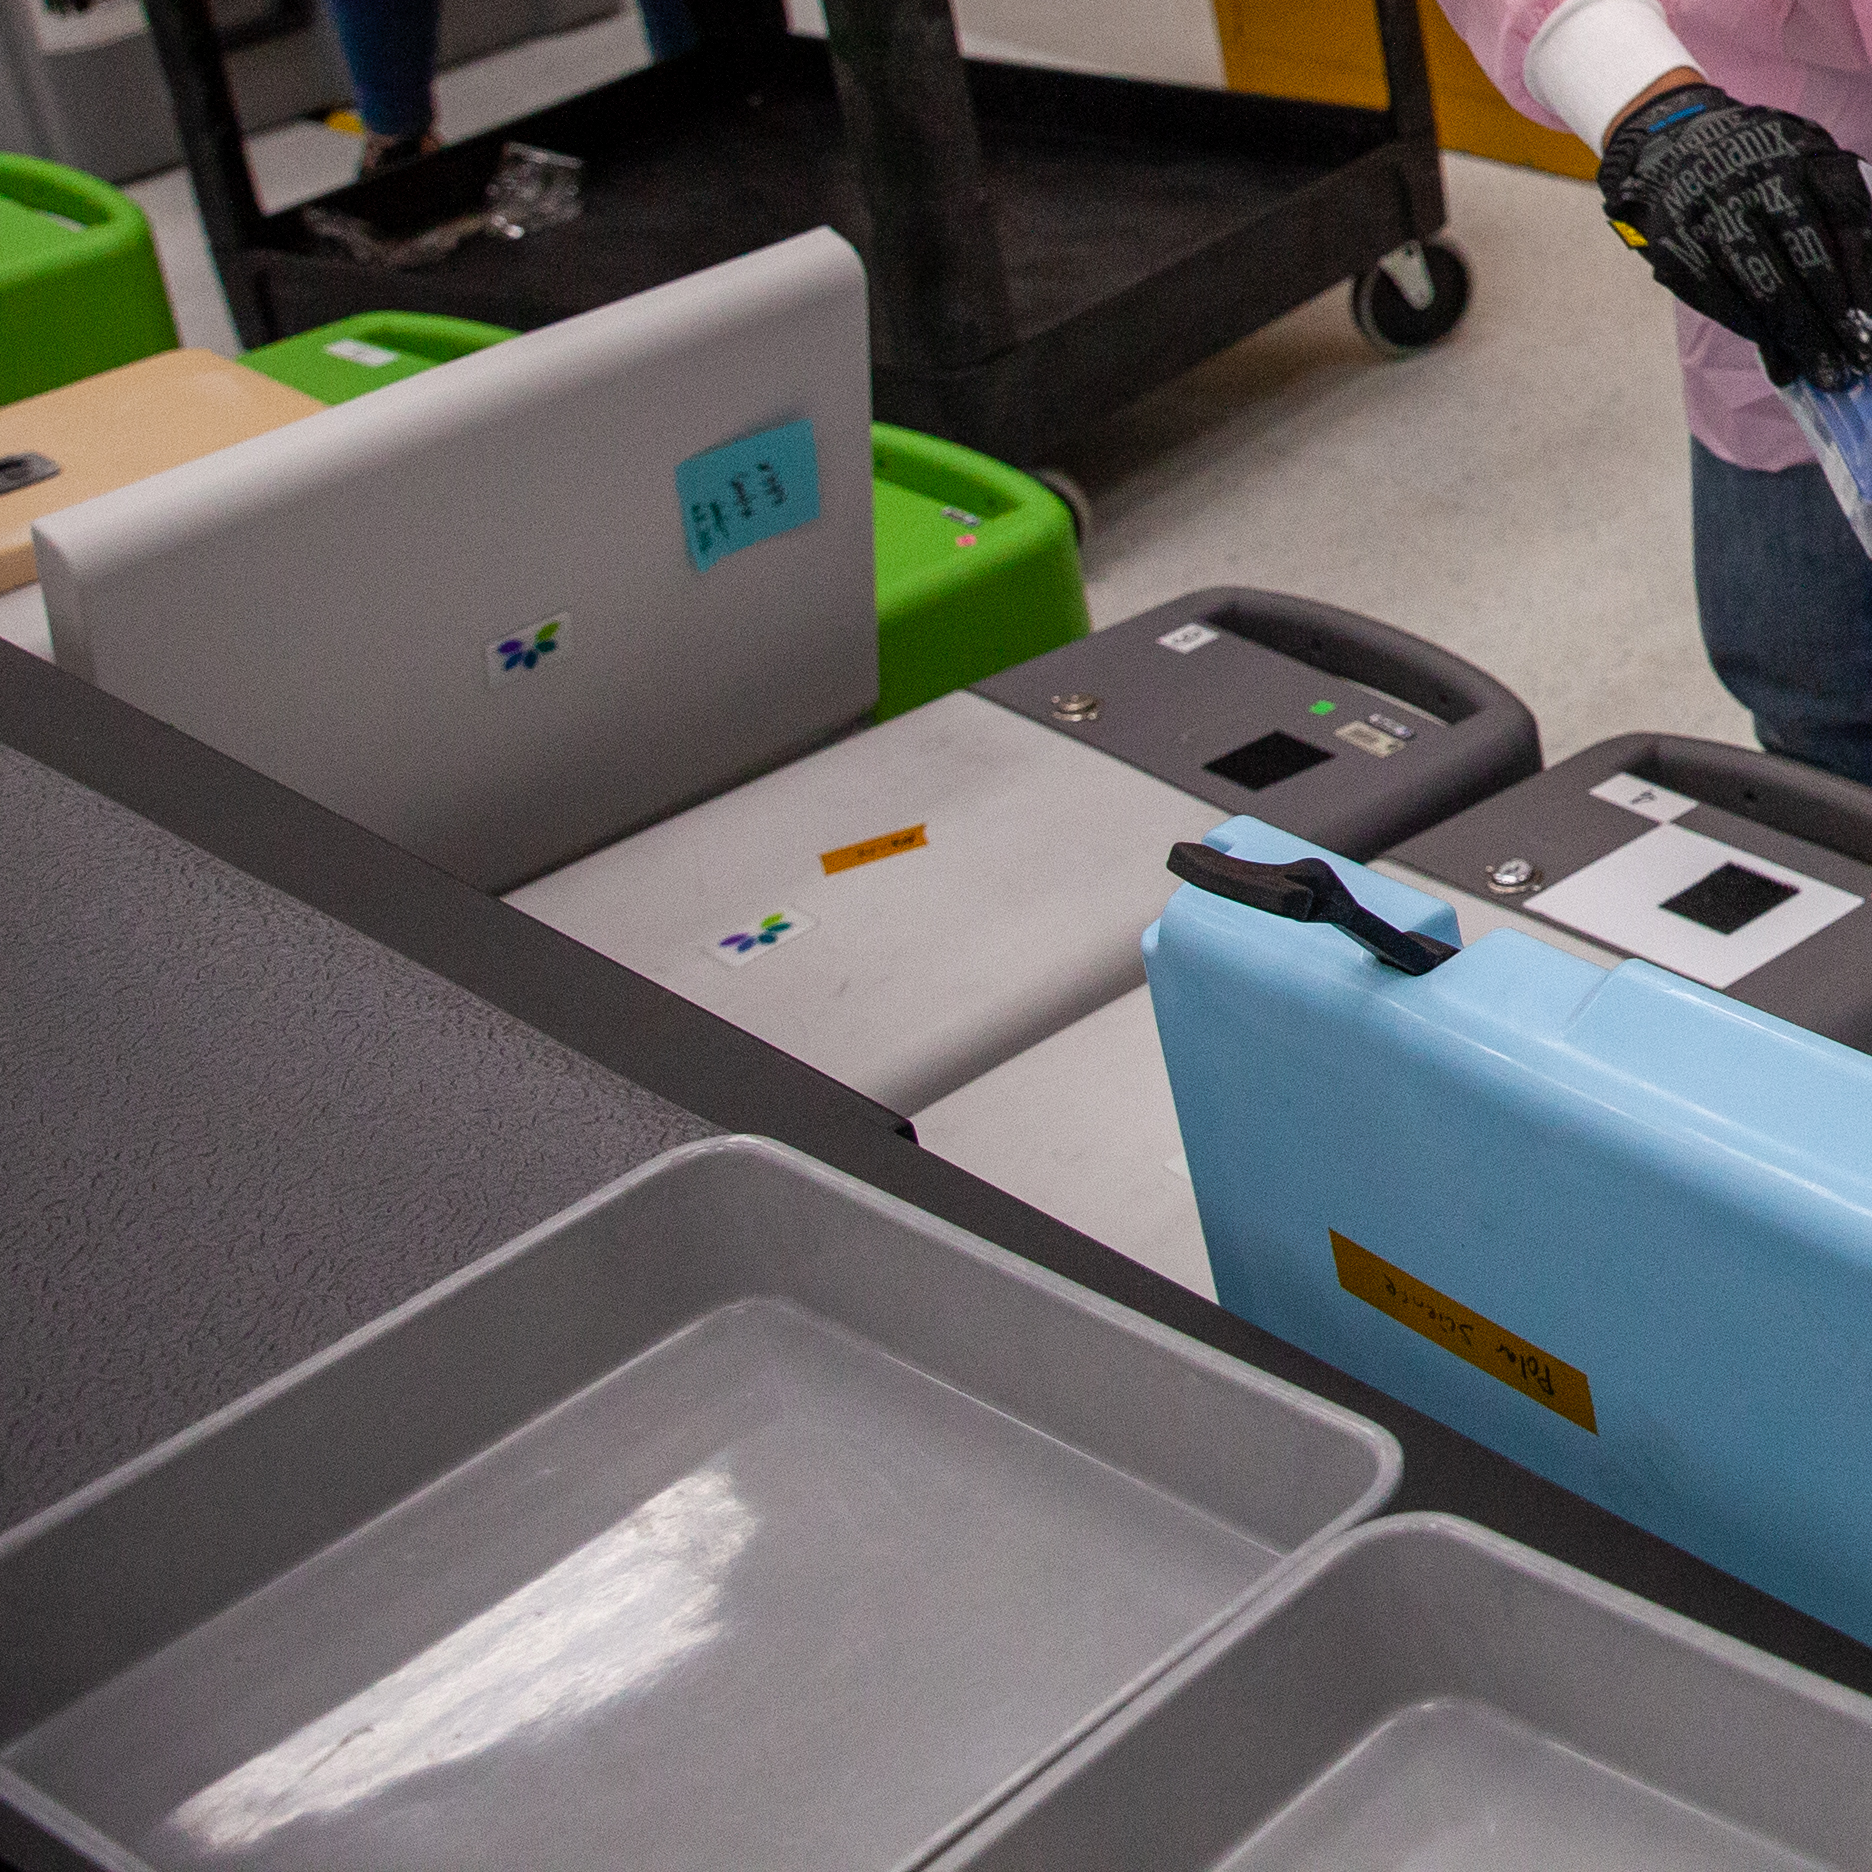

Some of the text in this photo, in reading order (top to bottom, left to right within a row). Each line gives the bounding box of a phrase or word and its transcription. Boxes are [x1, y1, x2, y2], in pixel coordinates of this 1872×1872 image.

[1663, 120, 1800, 226] Mechanix
[1382, 1273, 1557, 1397] Polar Science
